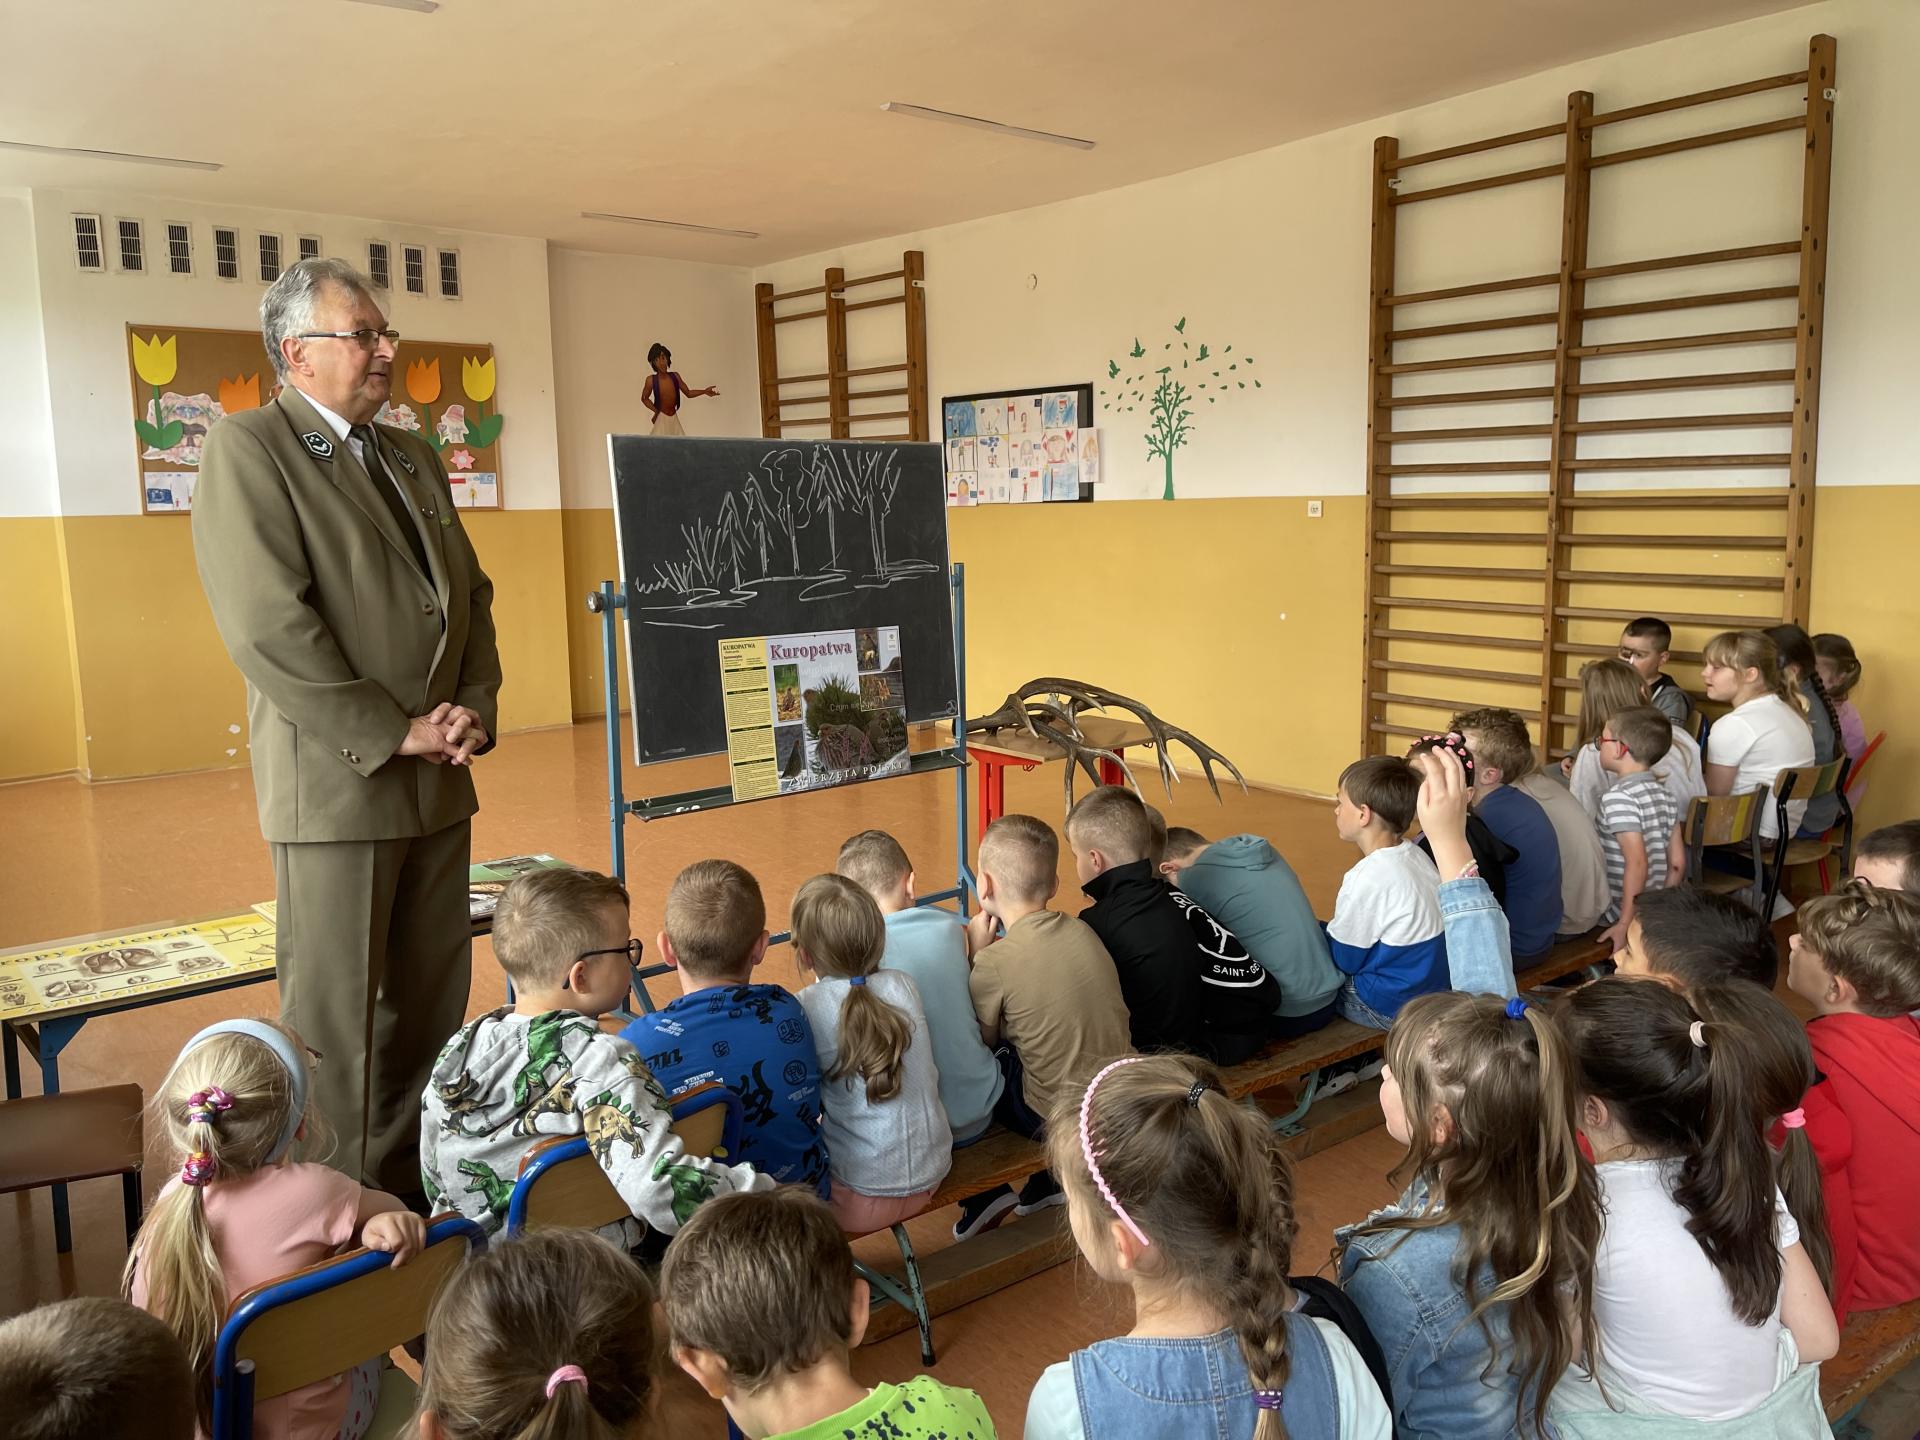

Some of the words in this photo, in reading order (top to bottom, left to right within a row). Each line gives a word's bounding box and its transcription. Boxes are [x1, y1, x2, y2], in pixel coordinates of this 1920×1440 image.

[723, 643, 756, 651] KUROPATWA
[770, 642, 852, 661] Kuropatwa
[788, 769, 857, 788] ZWIERZĘTA
[863, 761, 903, 775] POLSKI
